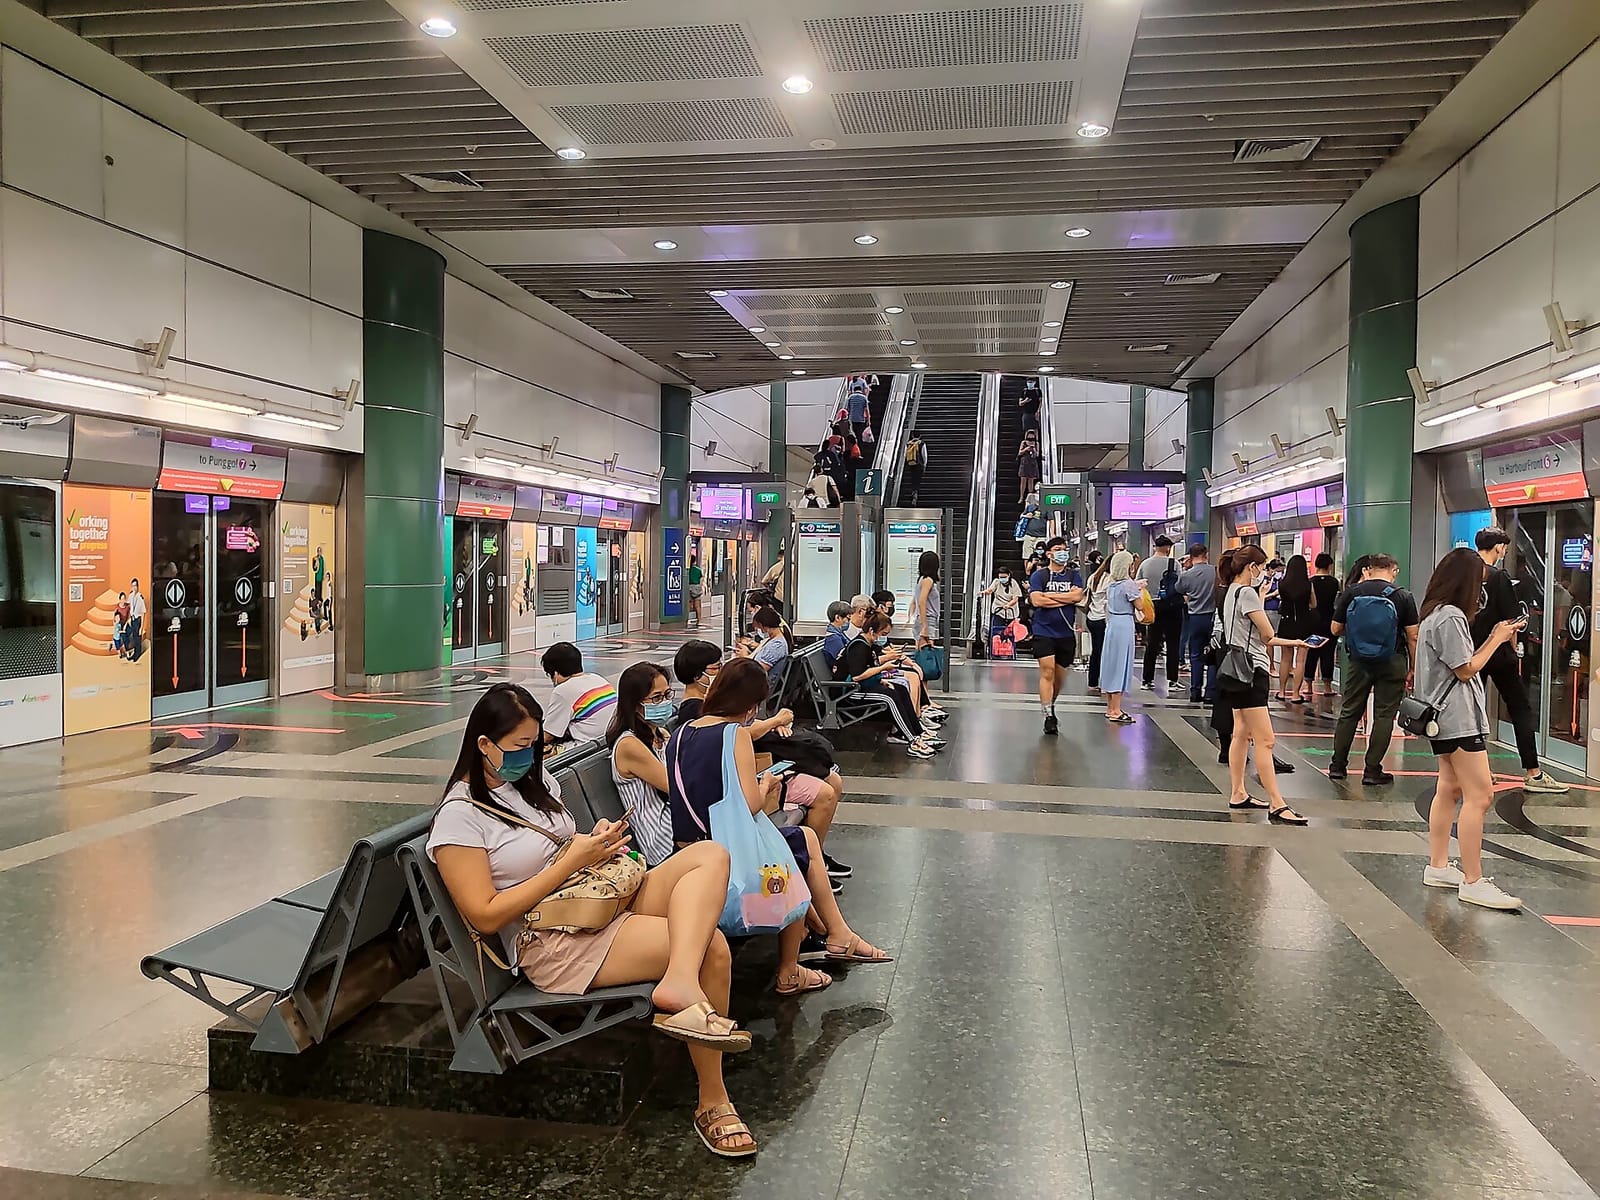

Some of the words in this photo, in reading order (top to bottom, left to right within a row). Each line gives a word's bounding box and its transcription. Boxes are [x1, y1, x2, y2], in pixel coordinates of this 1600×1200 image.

[199, 455, 207, 465] to
[209, 456, 238, 470] Punggol
[761, 495, 774, 503] EXIT
[1050, 496, 1065, 504] EXIT
[70, 527, 108, 542] together
